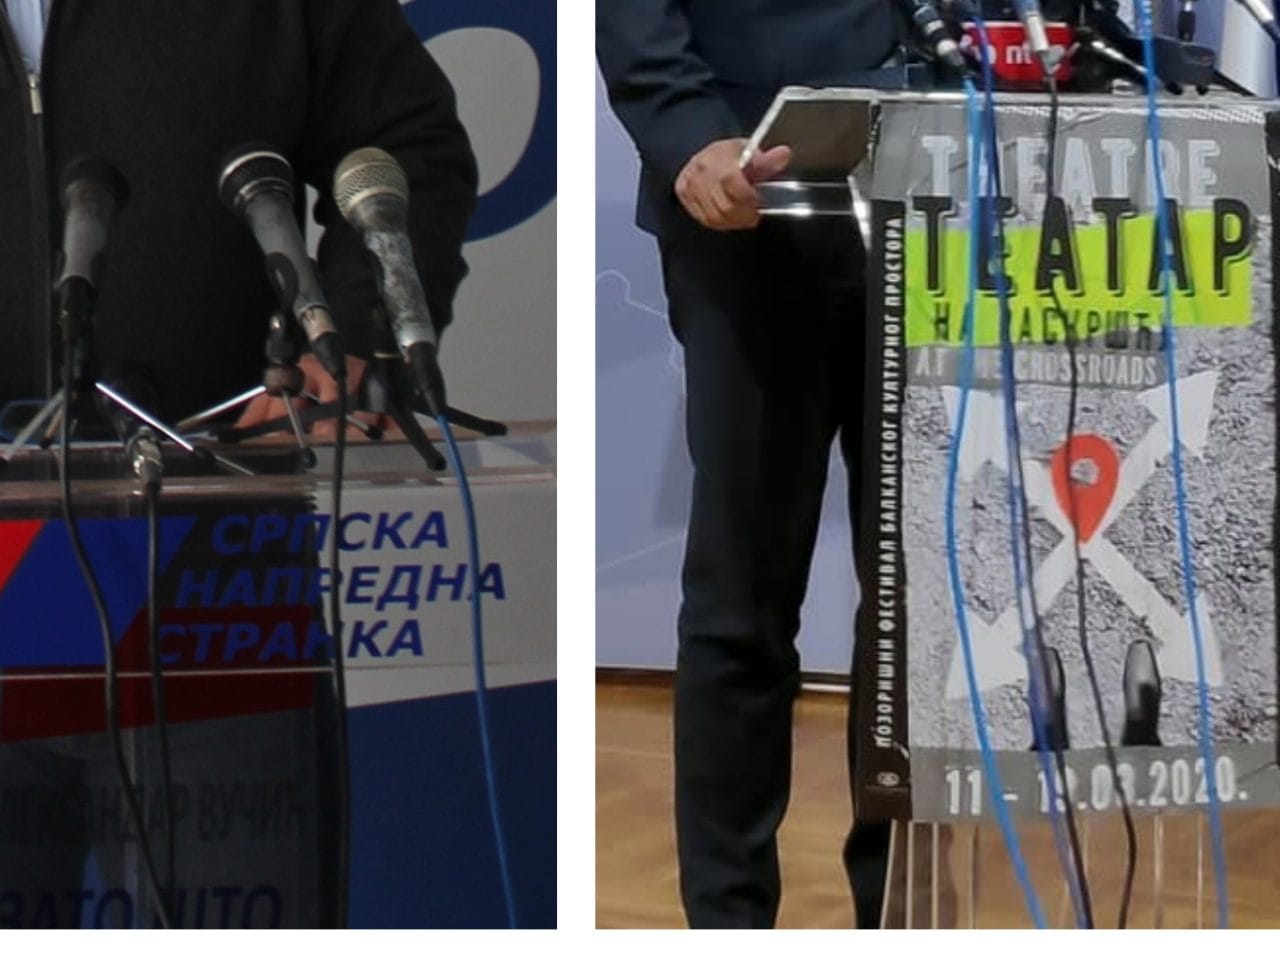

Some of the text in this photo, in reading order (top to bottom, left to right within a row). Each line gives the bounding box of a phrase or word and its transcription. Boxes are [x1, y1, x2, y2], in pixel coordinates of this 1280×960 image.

[884, 218, 903, 306] ПРОСТОРА
[912, 196, 1254, 297] ТЕАТАР
[882, 313, 901, 412] КУЛТУРНОГ
[1014, 350, 1158, 385] CROSSROADS
[880, 422, 899, 532] БАЛКАНСКОГ
[212, 510, 449, 555] СРПСКА
[175, 562, 507, 612] НАПРЕДНА
[878, 540, 898, 632] ФЕСТИВАЛ
[157, 619, 425, 663] СТРАНКА
[945, 768, 982, 815] 11
